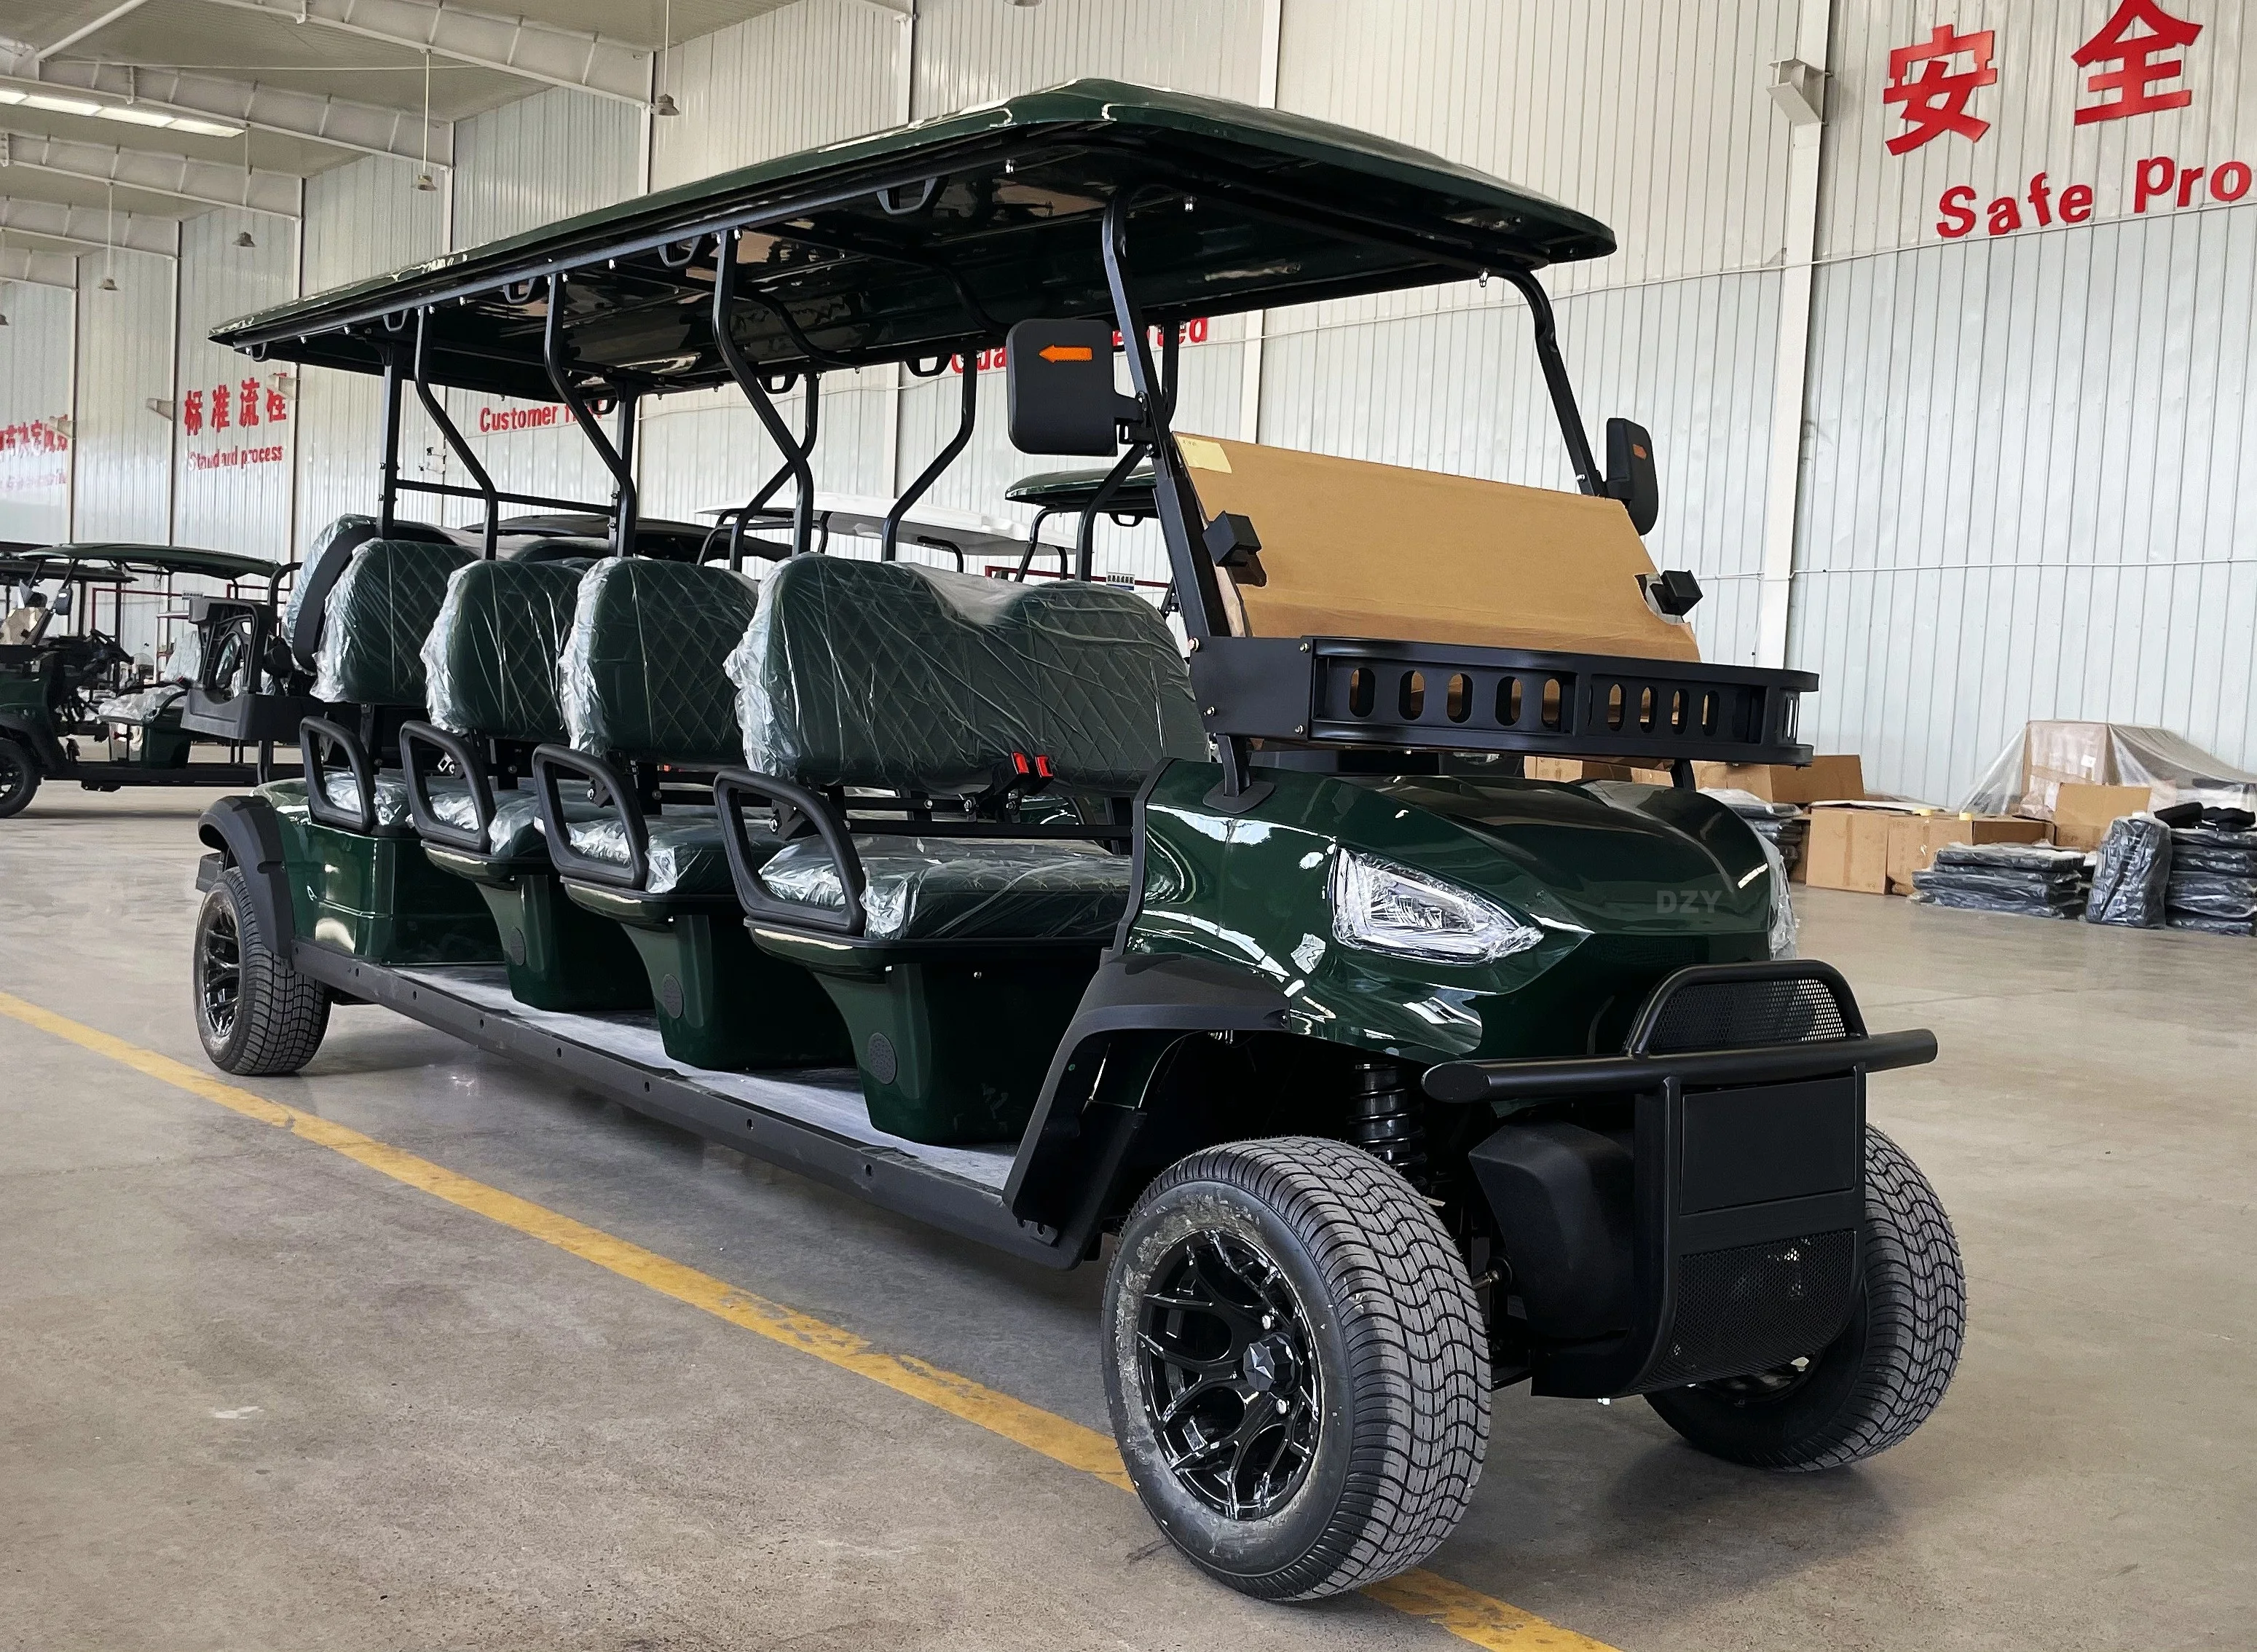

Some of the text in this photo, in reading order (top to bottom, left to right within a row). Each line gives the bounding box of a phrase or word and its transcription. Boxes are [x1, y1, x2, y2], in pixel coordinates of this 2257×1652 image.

[1882, 0, 2203, 156] 安全
[1935, 170, 2094, 239] Safe
[479, 405, 558, 433] Customer
[188, 445, 283, 471] Standard process
